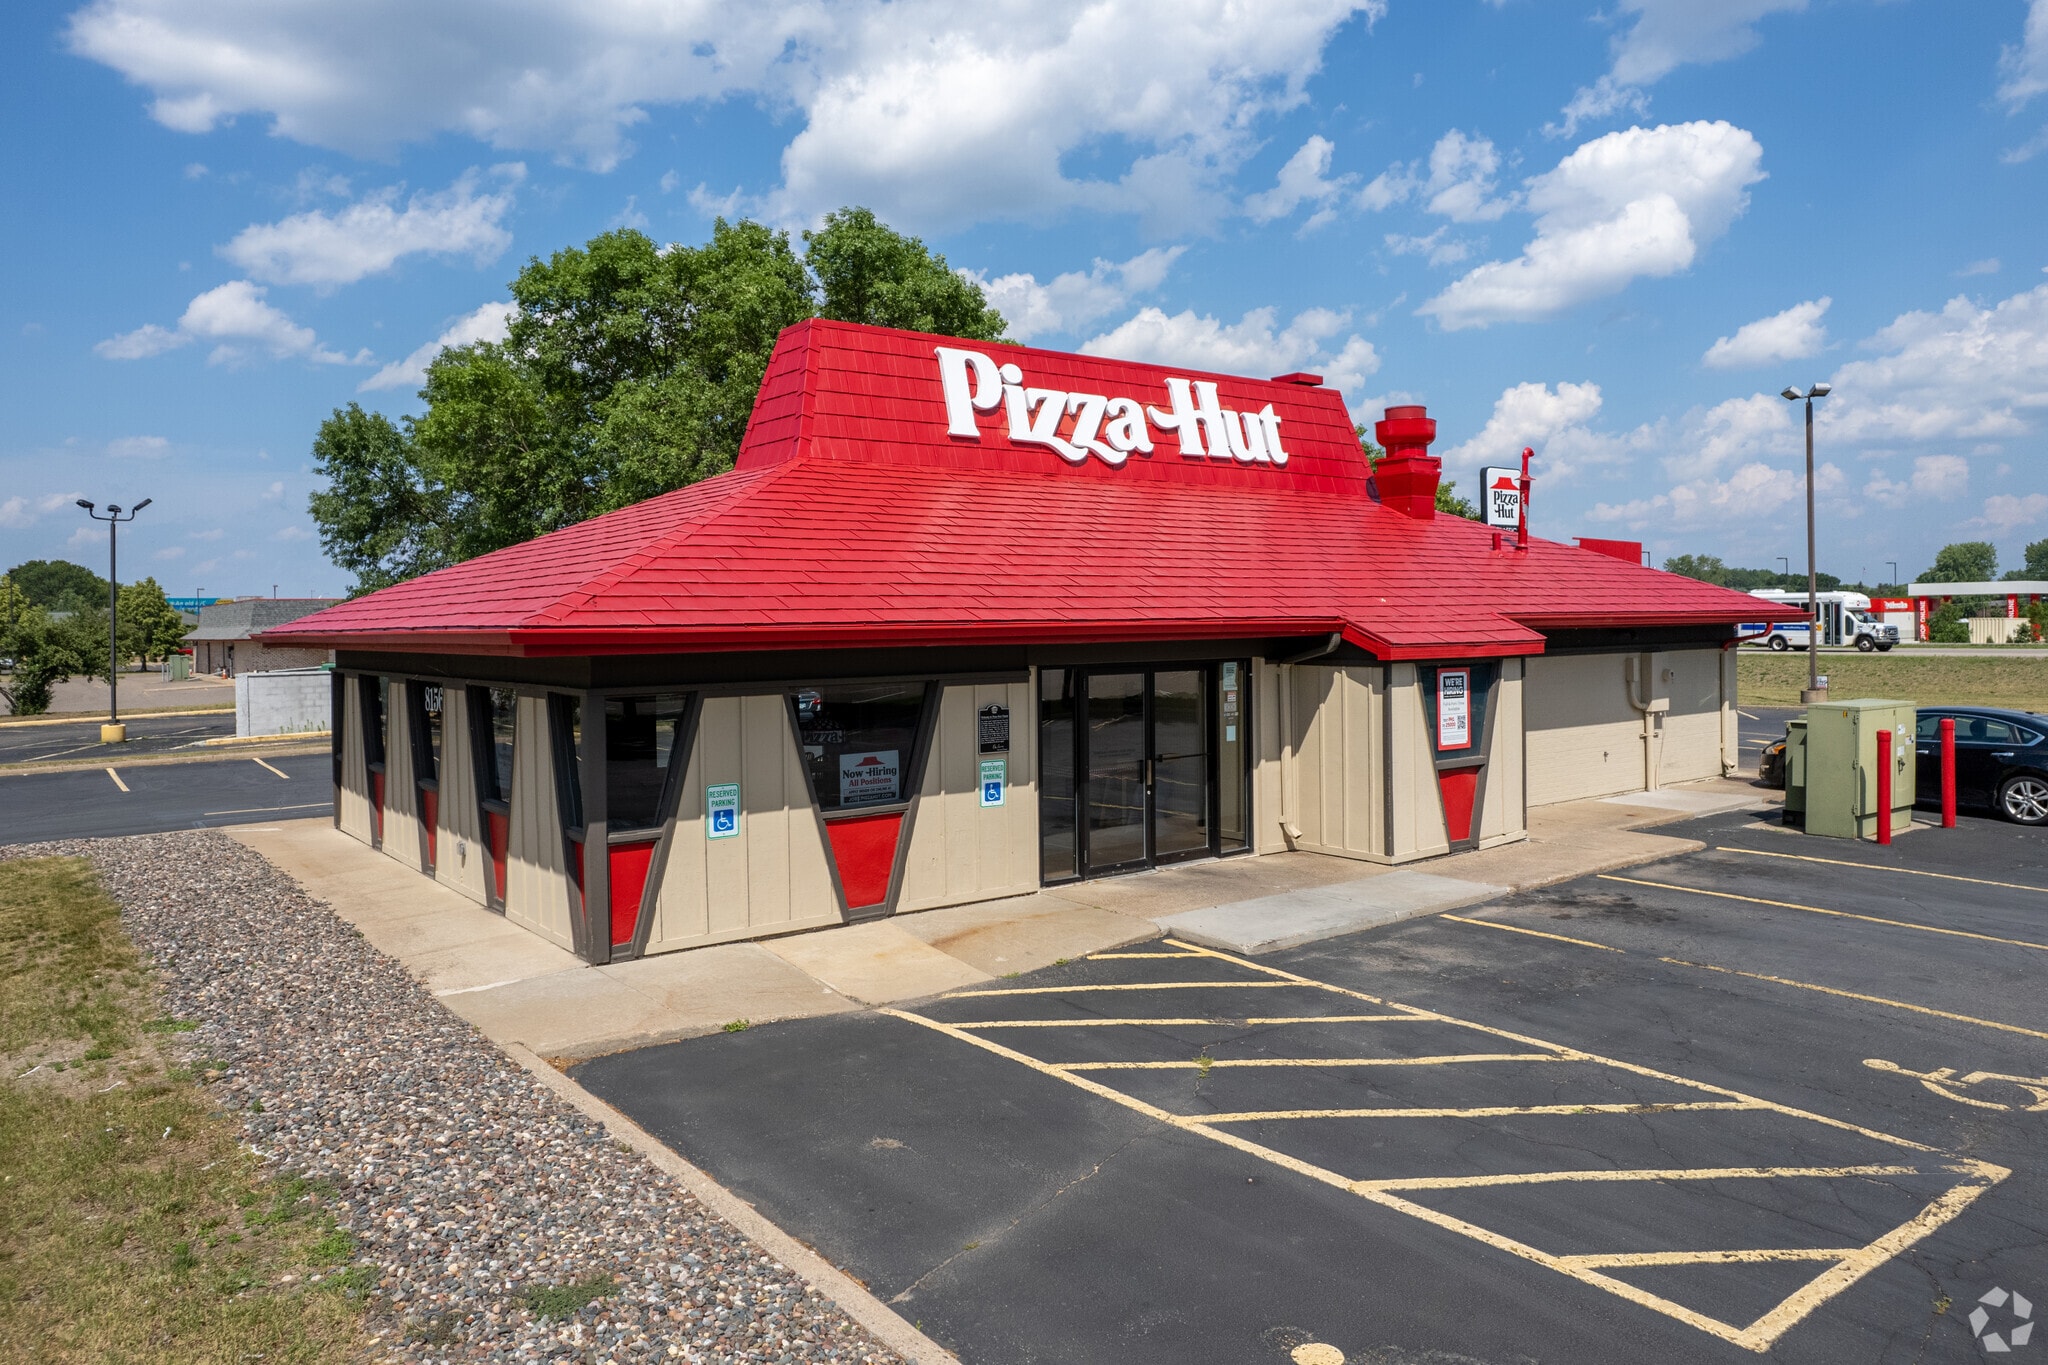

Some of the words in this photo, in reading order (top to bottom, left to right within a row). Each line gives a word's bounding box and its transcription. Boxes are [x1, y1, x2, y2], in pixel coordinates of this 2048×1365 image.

[934, 346, 1154, 466] Pizza
[1146, 377, 1289, 466] Hut
[1493, 490, 1518, 505] Pizza
[1494, 504, 1514, 518] Hut
[842, 769, 864, 779] Now
[865, 766, 897, 777] Hiring
[981, 764, 1004, 773] RESERVED
[982, 772, 1003, 780] PARKING
[849, 779, 859, 787] All
[860, 777, 892, 786] Positions
[709, 789, 737, 798] RESERVED
[711, 799, 736, 807] PARKING
